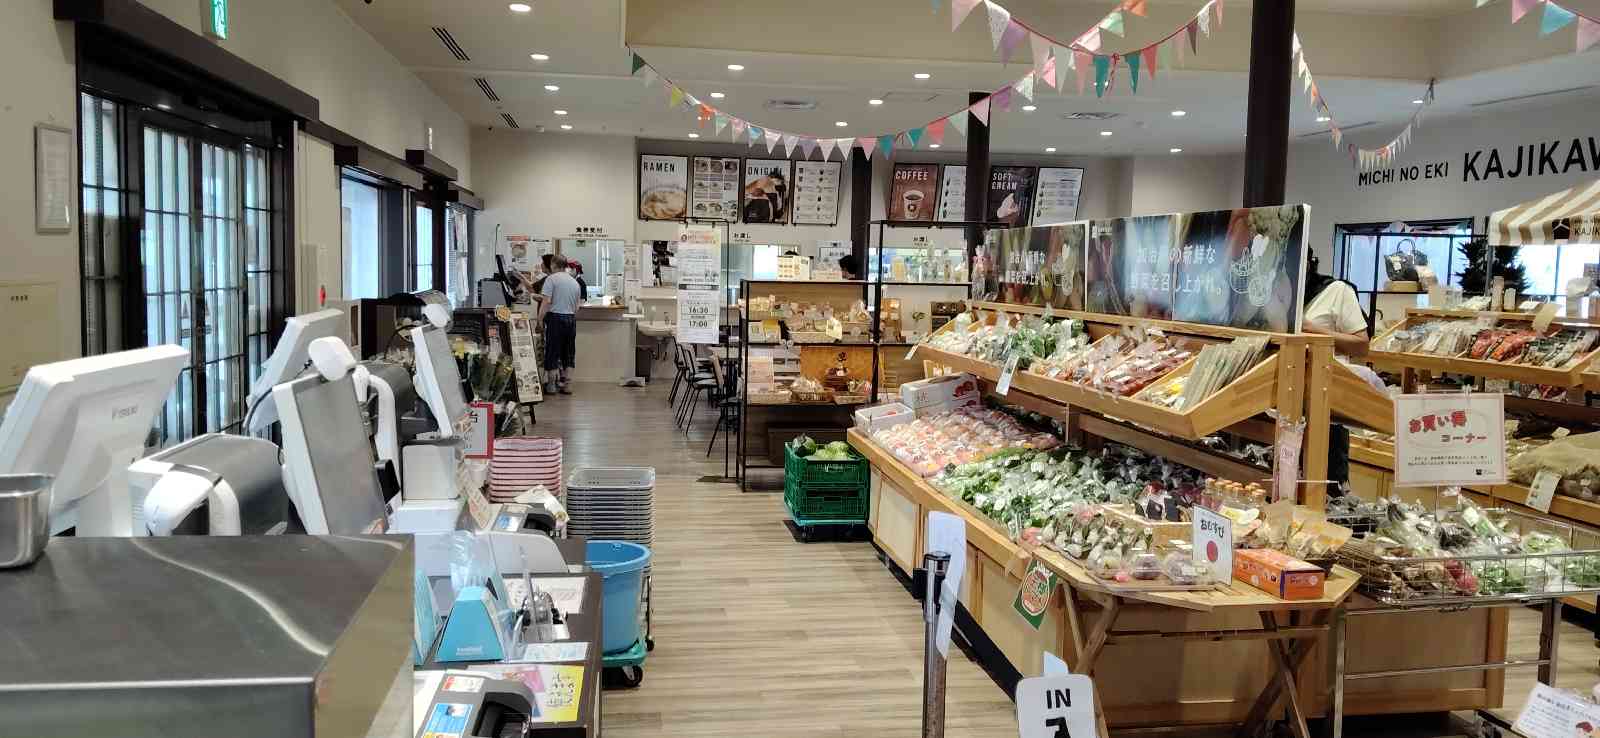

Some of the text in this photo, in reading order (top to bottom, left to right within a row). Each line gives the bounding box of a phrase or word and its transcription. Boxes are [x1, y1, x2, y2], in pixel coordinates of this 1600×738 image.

[643, 161, 676, 173] RAMEN
[895, 169, 929, 181] COFFEE
[992, 172, 1012, 181] SOFT
[1358, 168, 1395, 186] MICHI
[1400, 166, 1419, 181] NO
[1425, 162, 1449, 179] EKI
[991, 181, 1018, 191] CREAM
[689, 320, 708, 328] 17:00
[1409, 410, 1467, 433] お買い得
[1441, 432, 1487, 444] コーナー
[1046, 688, 1072, 709] IN
